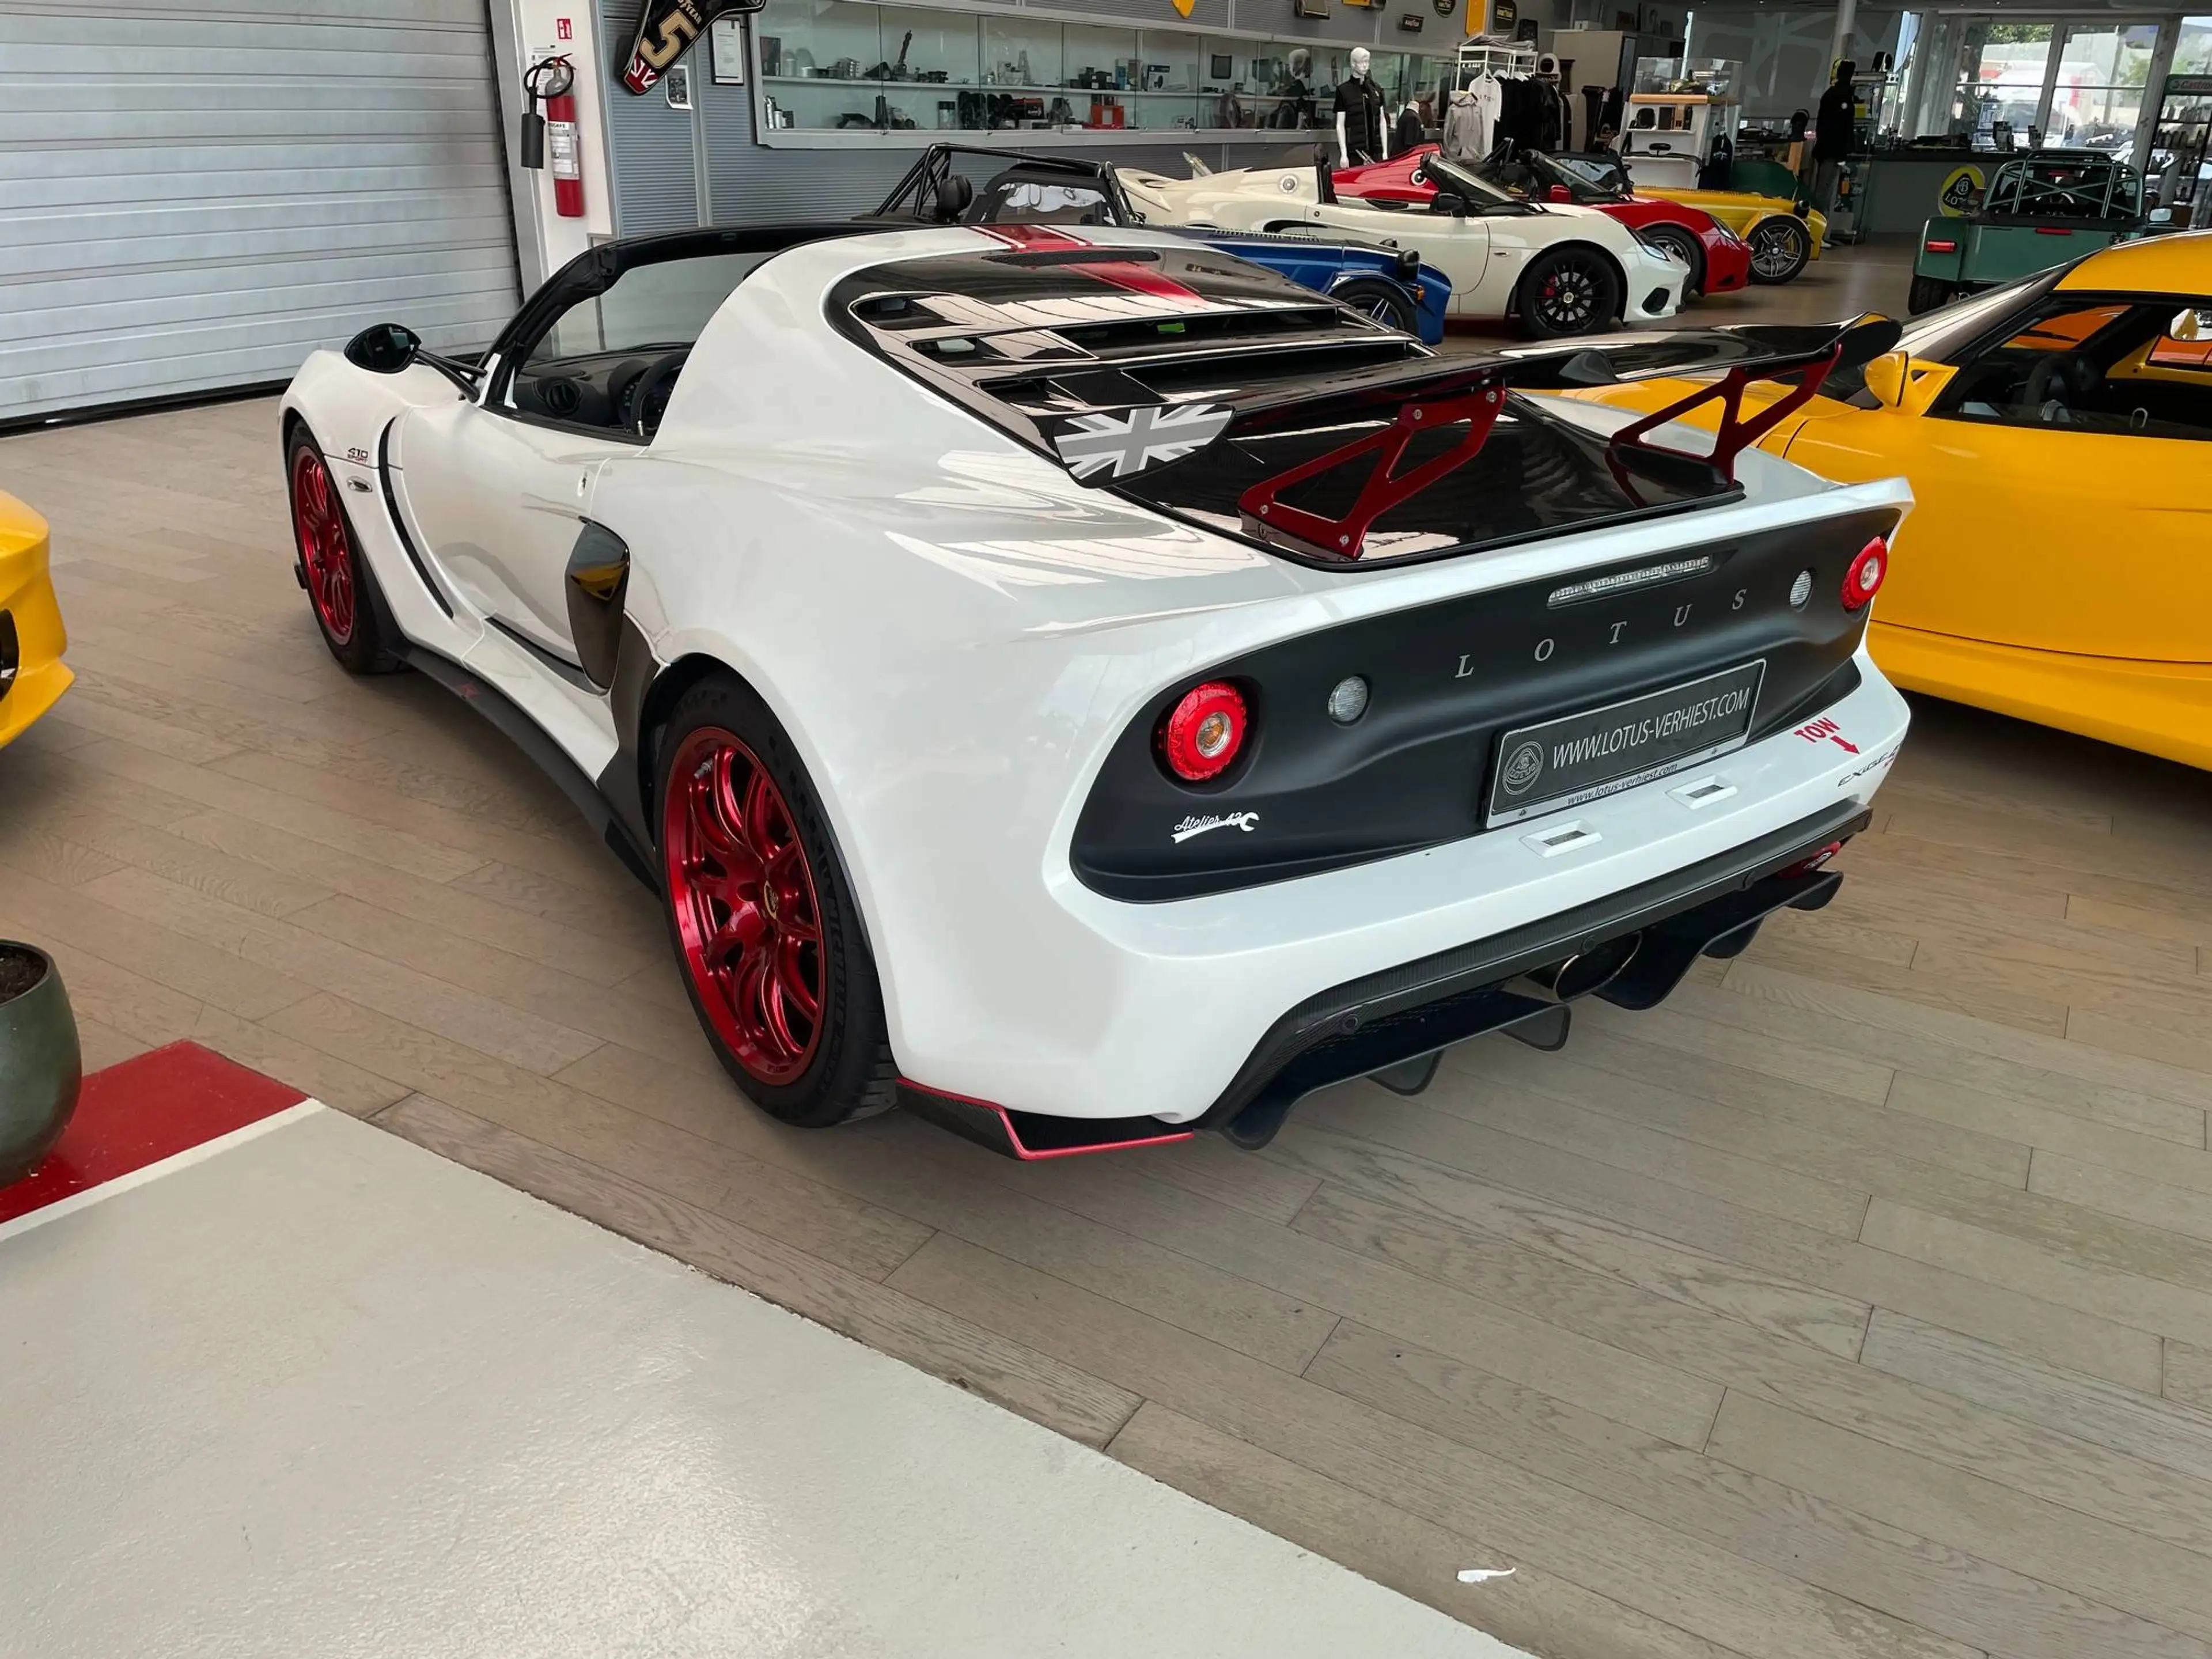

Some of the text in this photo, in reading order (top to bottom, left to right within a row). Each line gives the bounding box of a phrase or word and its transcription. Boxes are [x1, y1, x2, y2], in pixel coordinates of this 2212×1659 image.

[639, 9, 699, 69] 5
[348, 448, 368, 459] 410
[1455, 589, 1747, 678] LOTUS
[1553, 688, 1750, 769] WWW.LOTUS-VERHIEST.COM
[1794, 717, 1841, 743] TOW
[1567, 764, 1677, 805] www.lotus-verhiest.com
[1175, 816, 1222, 831] Atelier
